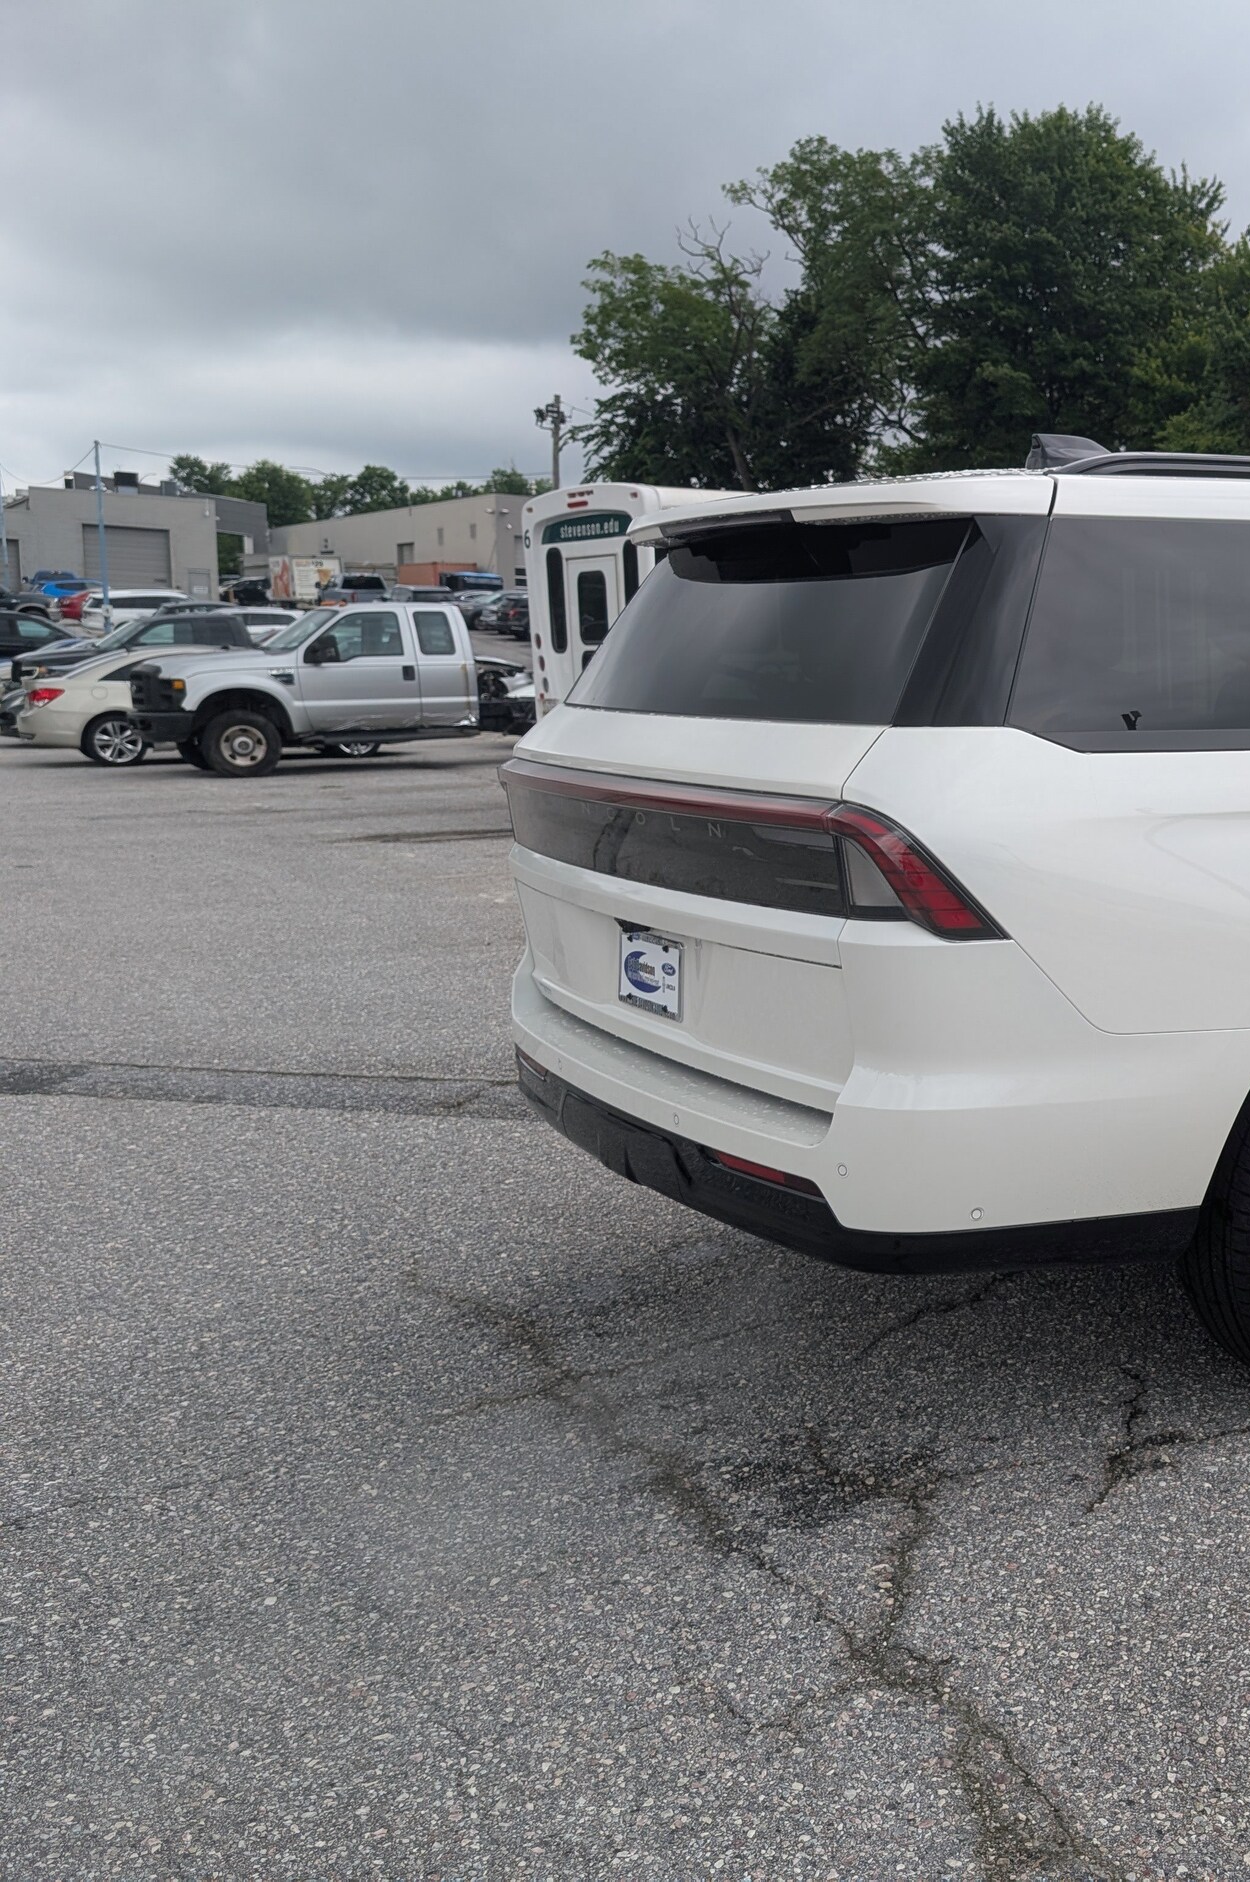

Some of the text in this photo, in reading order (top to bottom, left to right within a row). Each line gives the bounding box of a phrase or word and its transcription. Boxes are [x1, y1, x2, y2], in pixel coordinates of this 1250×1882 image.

[524, 529, 531, 549] 6
[560, 517, 619, 539] stevenson.edu
[578, 801, 722, 838] NCOLN
